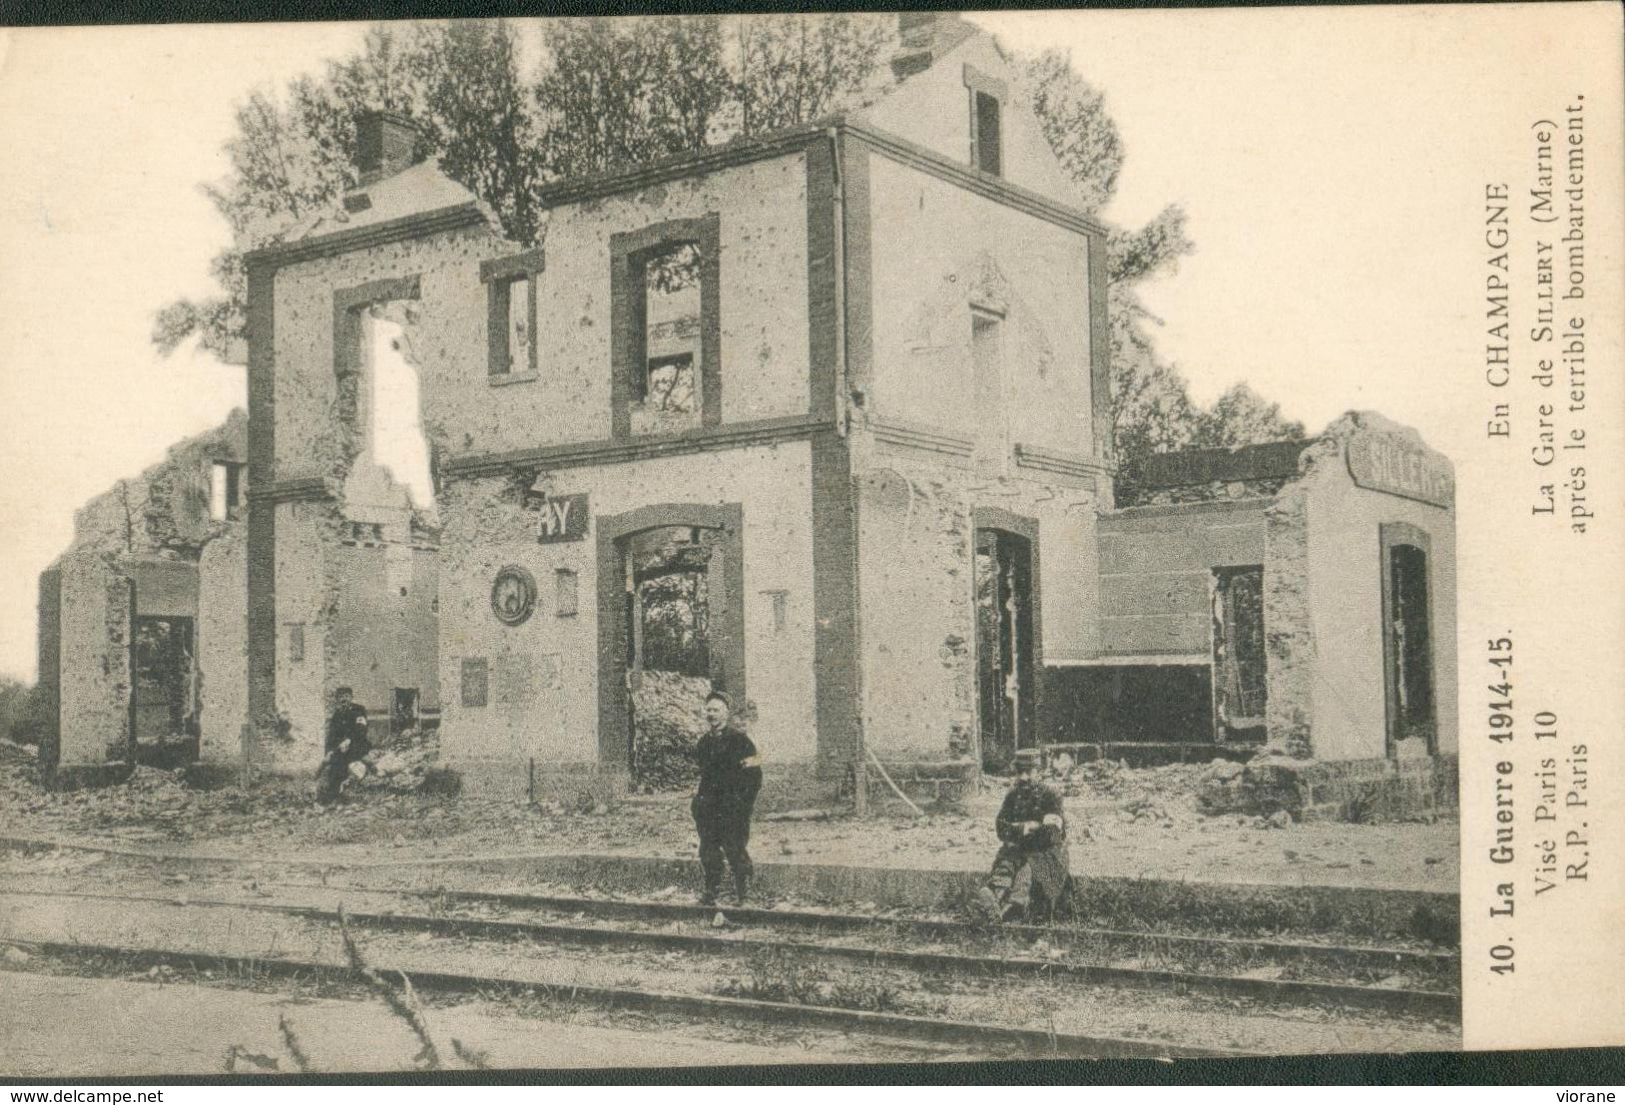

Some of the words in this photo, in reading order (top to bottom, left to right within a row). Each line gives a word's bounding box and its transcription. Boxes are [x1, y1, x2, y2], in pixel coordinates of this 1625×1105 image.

[1531, 120, 1558, 222] (Marne)
[1563, 95, 1584, 299] bombardement.
[1486, 184, 1509, 387] CHAMPAGNE
[1532, 360, 1553, 387] de
[1563, 318, 1585, 411] terrible
[1488, 405, 1509, 436] En
[1532, 405, 1554, 466] Gare
[1563, 429, 1585, 451] le
[1532, 485, 1554, 515] La
[1564, 467, 1593, 533] après
[1488, 630, 1513, 743] 1914-15.
[1535, 712, 1557, 740] 10
[1535, 758, 1556, 822] Paris
[1566, 745, 1587, 807] Paris
[1490, 761, 1514, 864] Guerre
[1535, 840, 1556, 895] Visé
[1566, 822, 1589, 881] R.P.
[1490, 882, 1514, 917] La
[1490, 938, 1515, 975] 10.
